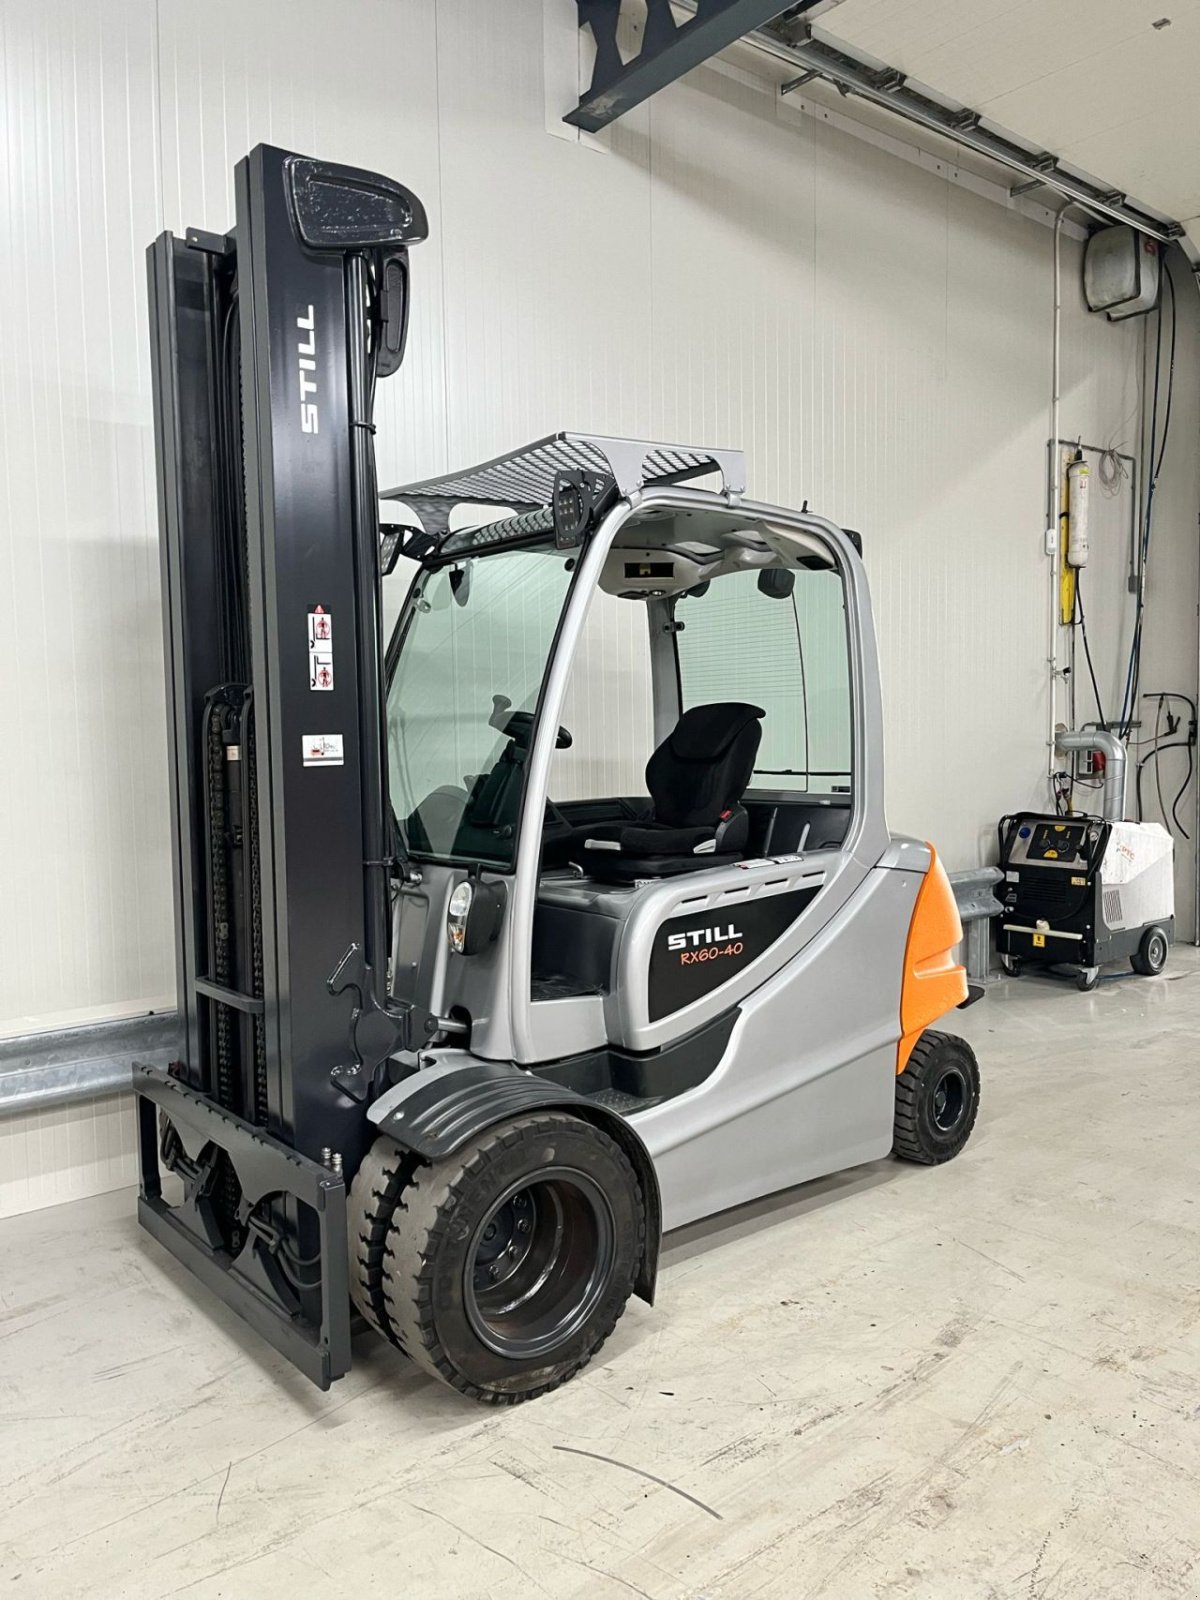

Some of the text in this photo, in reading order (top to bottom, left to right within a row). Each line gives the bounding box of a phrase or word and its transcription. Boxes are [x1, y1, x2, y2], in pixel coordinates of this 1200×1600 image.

[297, 304, 318, 434] STILL
[667, 924, 743, 951] STILL
[680, 942, 744, 965] RX60-40
